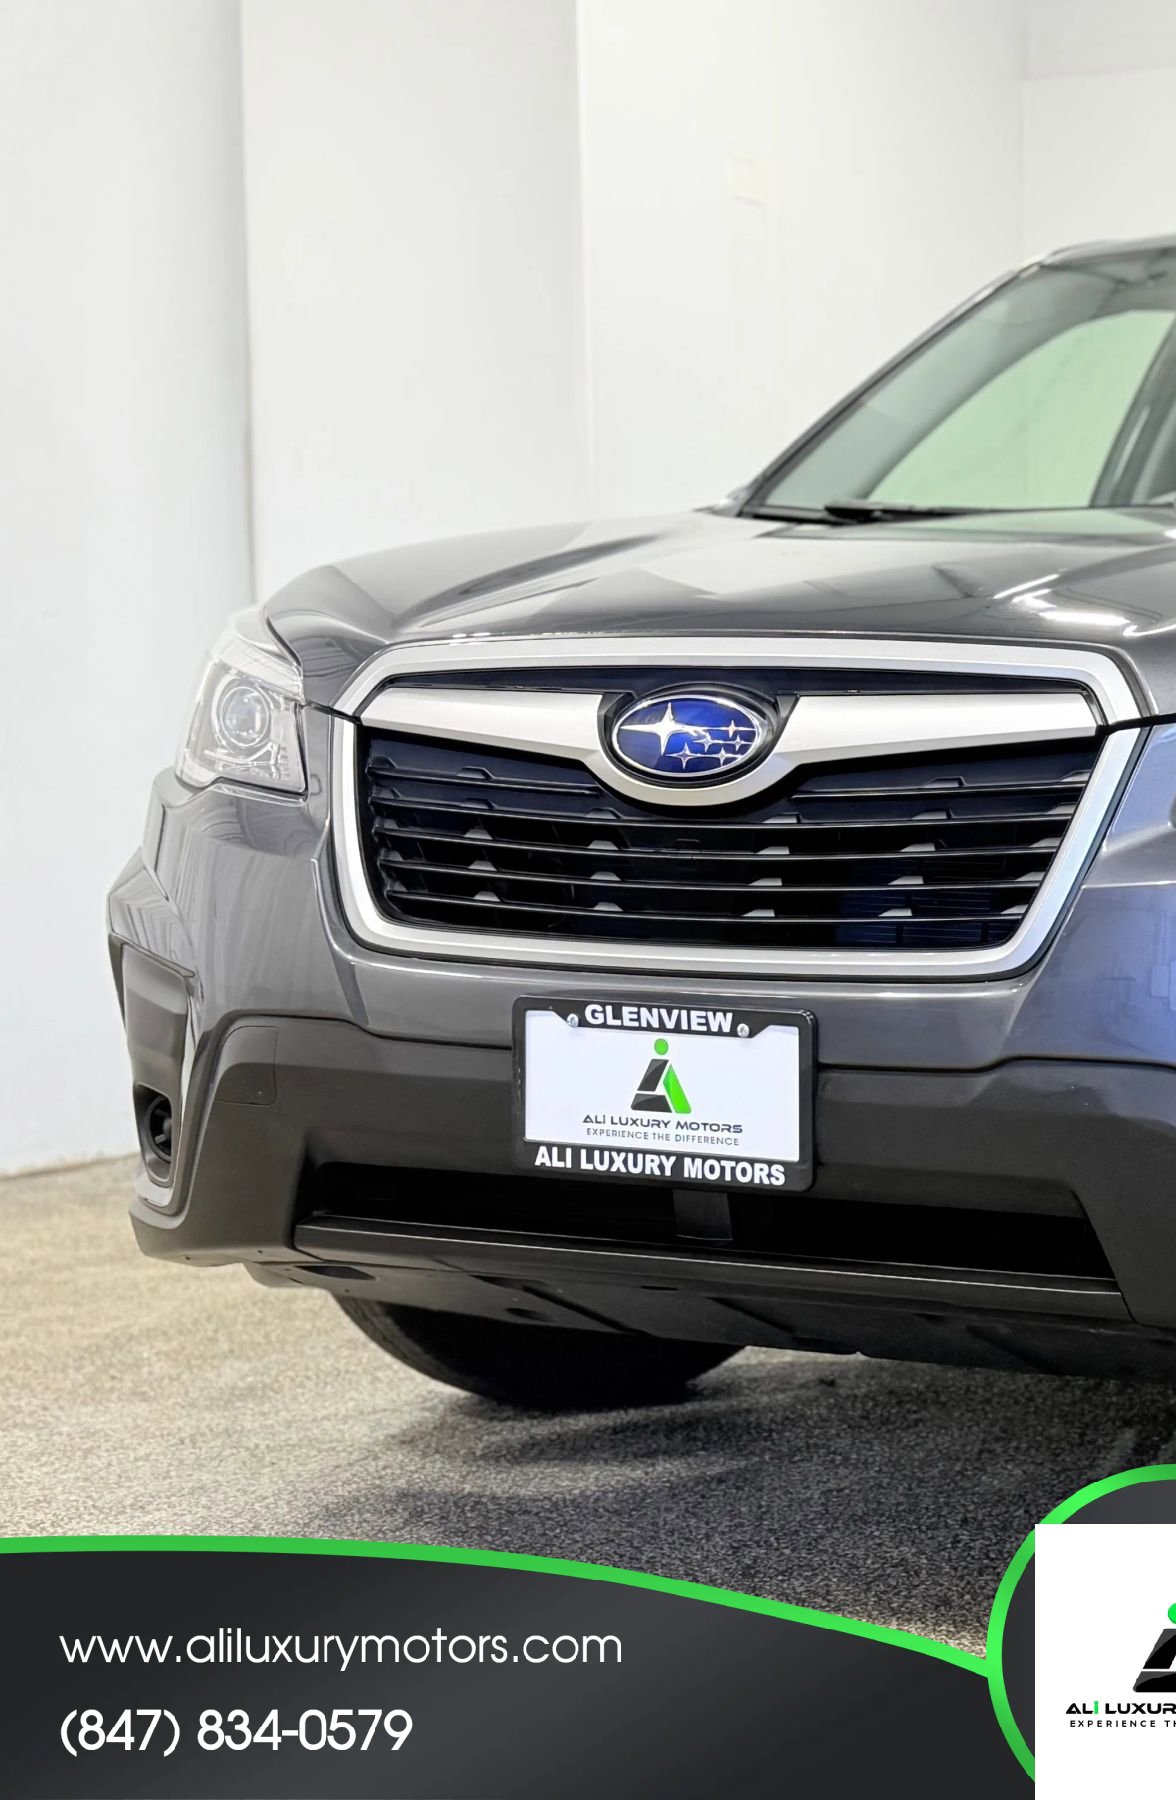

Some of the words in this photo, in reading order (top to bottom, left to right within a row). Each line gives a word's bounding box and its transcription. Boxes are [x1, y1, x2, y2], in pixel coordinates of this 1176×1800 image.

[584, 1003, 734, 1033] GLENVIEW
[586, 1127, 649, 1140] EXPERIENCE
[652, 1132, 670, 1142] THE
[674, 1134, 740, 1146] DIFFERENCE
[610, 1115, 671, 1129] LUXURY
[675, 1120, 743, 1134] MOTORS
[534, 1145, 572, 1169] ALI
[580, 1148, 677, 1177] LUXURY
[683, 1157, 786, 1186] MOTORS
